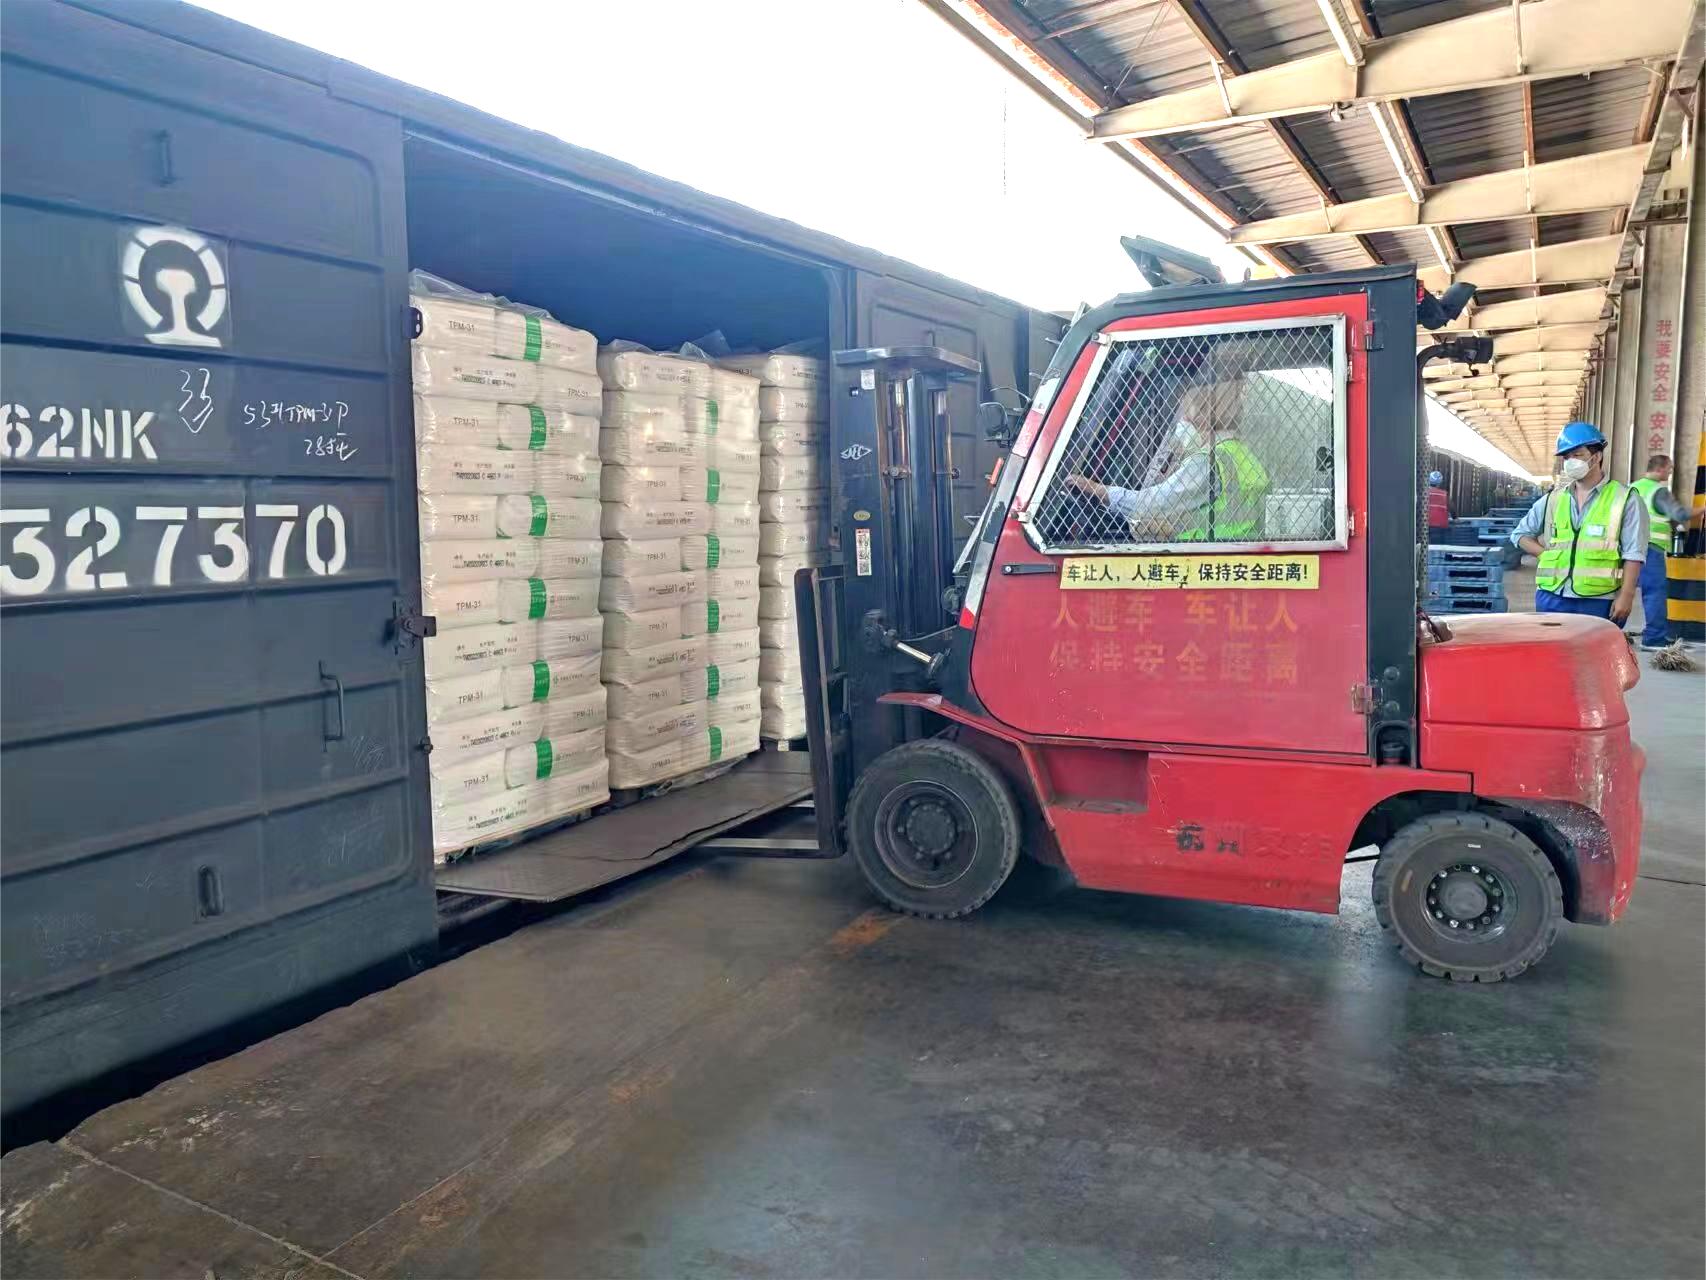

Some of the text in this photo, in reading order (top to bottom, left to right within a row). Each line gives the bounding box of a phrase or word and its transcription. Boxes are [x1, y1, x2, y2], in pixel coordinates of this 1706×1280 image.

[1649, 319, 1672, 451] 我要安全 安全
[0, 403, 158, 460] 62NK
[453, 514, 479, 523] TPM-31
[0, 504, 346, 596] 327370
[1184, 593, 1298, 633] 车让人
